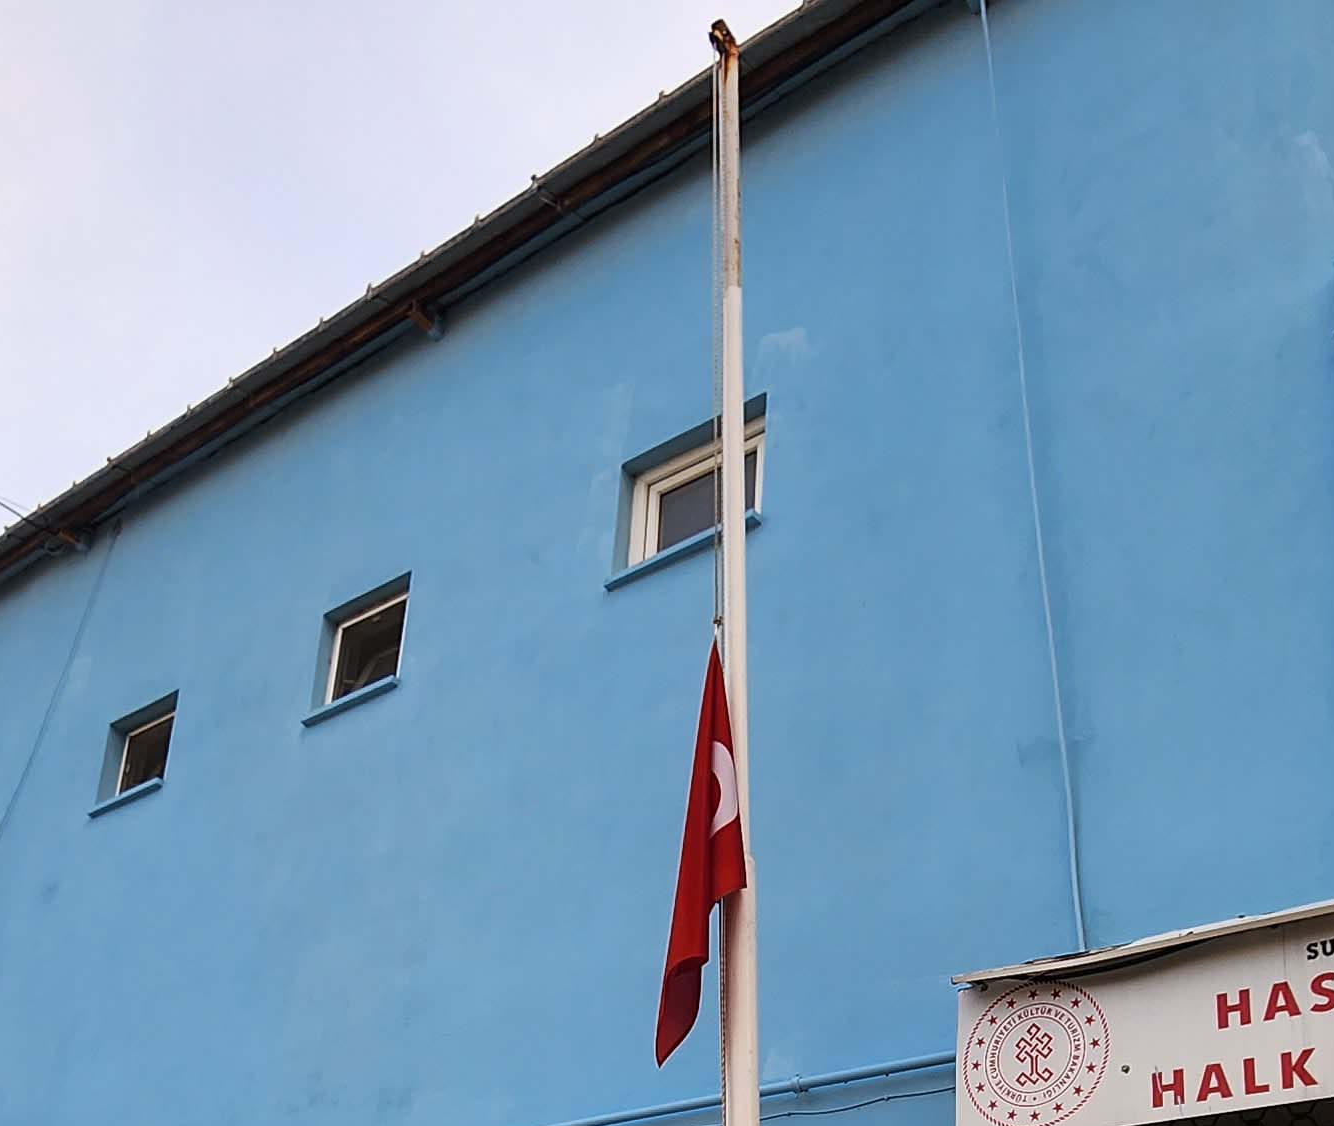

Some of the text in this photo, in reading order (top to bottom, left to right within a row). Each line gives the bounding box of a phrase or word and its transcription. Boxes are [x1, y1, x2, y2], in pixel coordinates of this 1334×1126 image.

[1017, 1006, 1053, 1021] KÜLTÜR
[1054, 1009, 1066, 1021] VE
[1151, 1047, 1318, 1109] HALK
